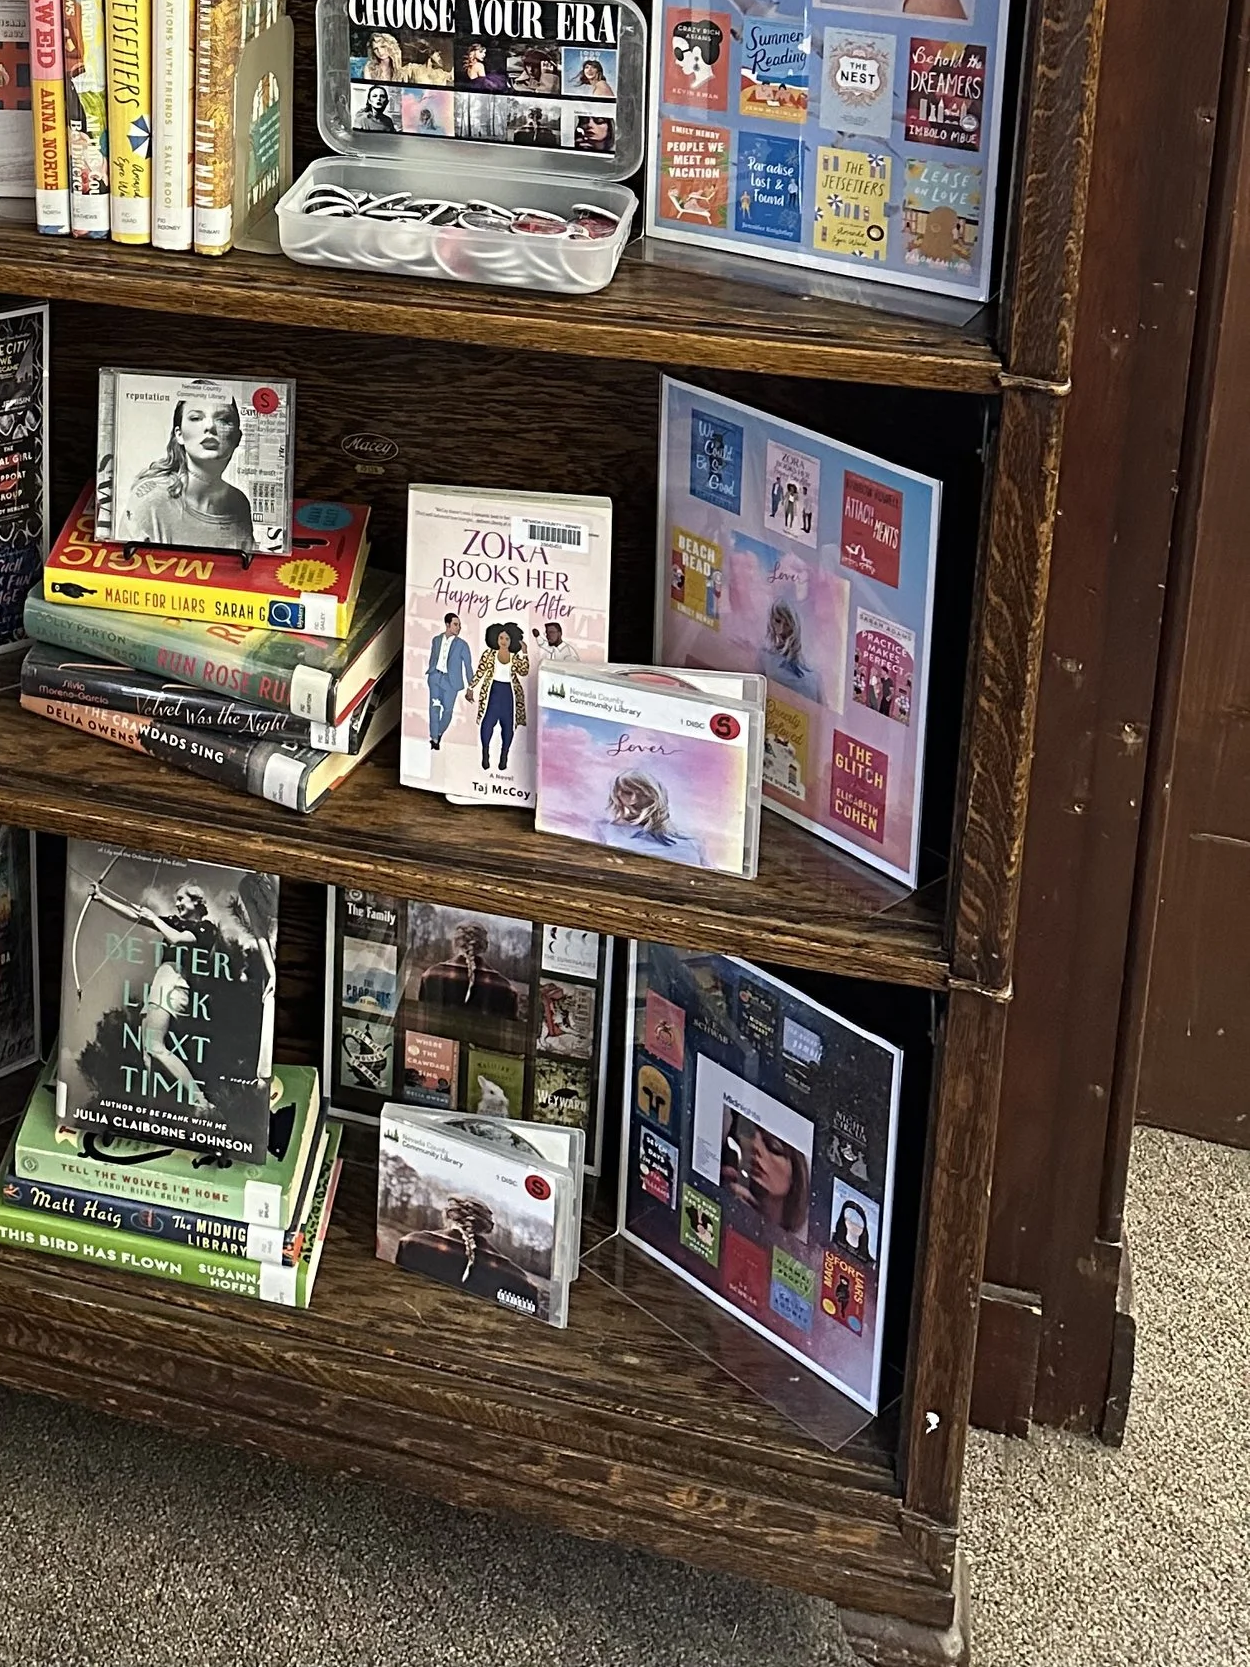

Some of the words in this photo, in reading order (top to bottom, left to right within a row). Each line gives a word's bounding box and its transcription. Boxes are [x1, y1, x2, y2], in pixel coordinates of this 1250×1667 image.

[557, 2, 616, 43] ERA
[750, 27, 803, 52] Summer
[752, 48, 807, 74] Reading
[850, 61, 867, 71] THE
[840, 71, 875, 85] NEST
[910, 72, 981, 99] DREAMERS
[41, 89, 55, 132] ANNA
[667, 141, 704, 153] PEOPLE
[708, 143, 724, 153] WE
[669, 167, 720, 180] VACATION
[822, 173, 884, 197] JETSETTERS
[126, 392, 170, 401] reputation
[349, 438, 392, 453] Macey
[678, 535, 716, 562] BEACH
[59, 548, 215, 579] MAGIC
[442, 559, 519, 586] BOOKS
[527, 568, 570, 592] HER
[682, 554, 711, 576] READ
[768, 562, 808, 583] Lover
[105, 589, 139, 606] MAGIC
[145, 594, 165, 607] FOR
[171, 598, 205, 613] LIARS
[216, 603, 253, 618] SARAH
[434, 578, 491, 616] Happy
[496, 588, 531, 612] Ever
[535, 593, 575, 619] After
[157, 647, 199, 675] RUN
[204, 659, 248, 689] ROSE
[47, 704, 83, 726] DELIA
[88, 720, 135, 745] OWENS
[112, 713, 188, 749] CRAWDADS
[190, 743, 224, 764] SING
[607, 734, 686, 755] Lover
[835, 752, 883, 788] GLITCH
[473, 781, 488, 795] Taj
[492, 785, 530, 800] McCoy
[835, 799, 878, 832] COHEN
[348, 903, 363, 917] The
[366, 906, 396, 925] Family
[106, 932, 232, 981] BETTER
[124, 980, 210, 1020] LUCK
[123, 1023, 210, 1063] NEXT
[121, 1066, 205, 1106] TIME
[537, 1089, 587, 1110] WEYWARD
[73, 1108, 109, 1126] JULIA
[113, 1116, 186, 1142] CLAIBORNE
[190, 1132, 252, 1153] JOHNSON
[62, 1164, 88, 1175] TELL
[94, 1168, 117, 1180] THE
[122, 1174, 168, 1191] WOLVES
[172, 1185, 190, 1195] I'M
[194, 1190, 229, 1203] HOME
[30, 1187, 77, 1213] Matt
[83, 1201, 121, 1228] Haig
[0, 1226, 34, 1246] THIS
[40, 1234, 78, 1252] BIRD
[83, 1243, 115, 1261] HAS
[122, 1251, 182, 1275] FLOWN
[824, 1252, 834, 1287] MAGIC
[834, 1256, 856, 1274] FOR
[853, 1268, 865, 1304] LIARS
[210, 1278, 255, 1294] HOFFS
